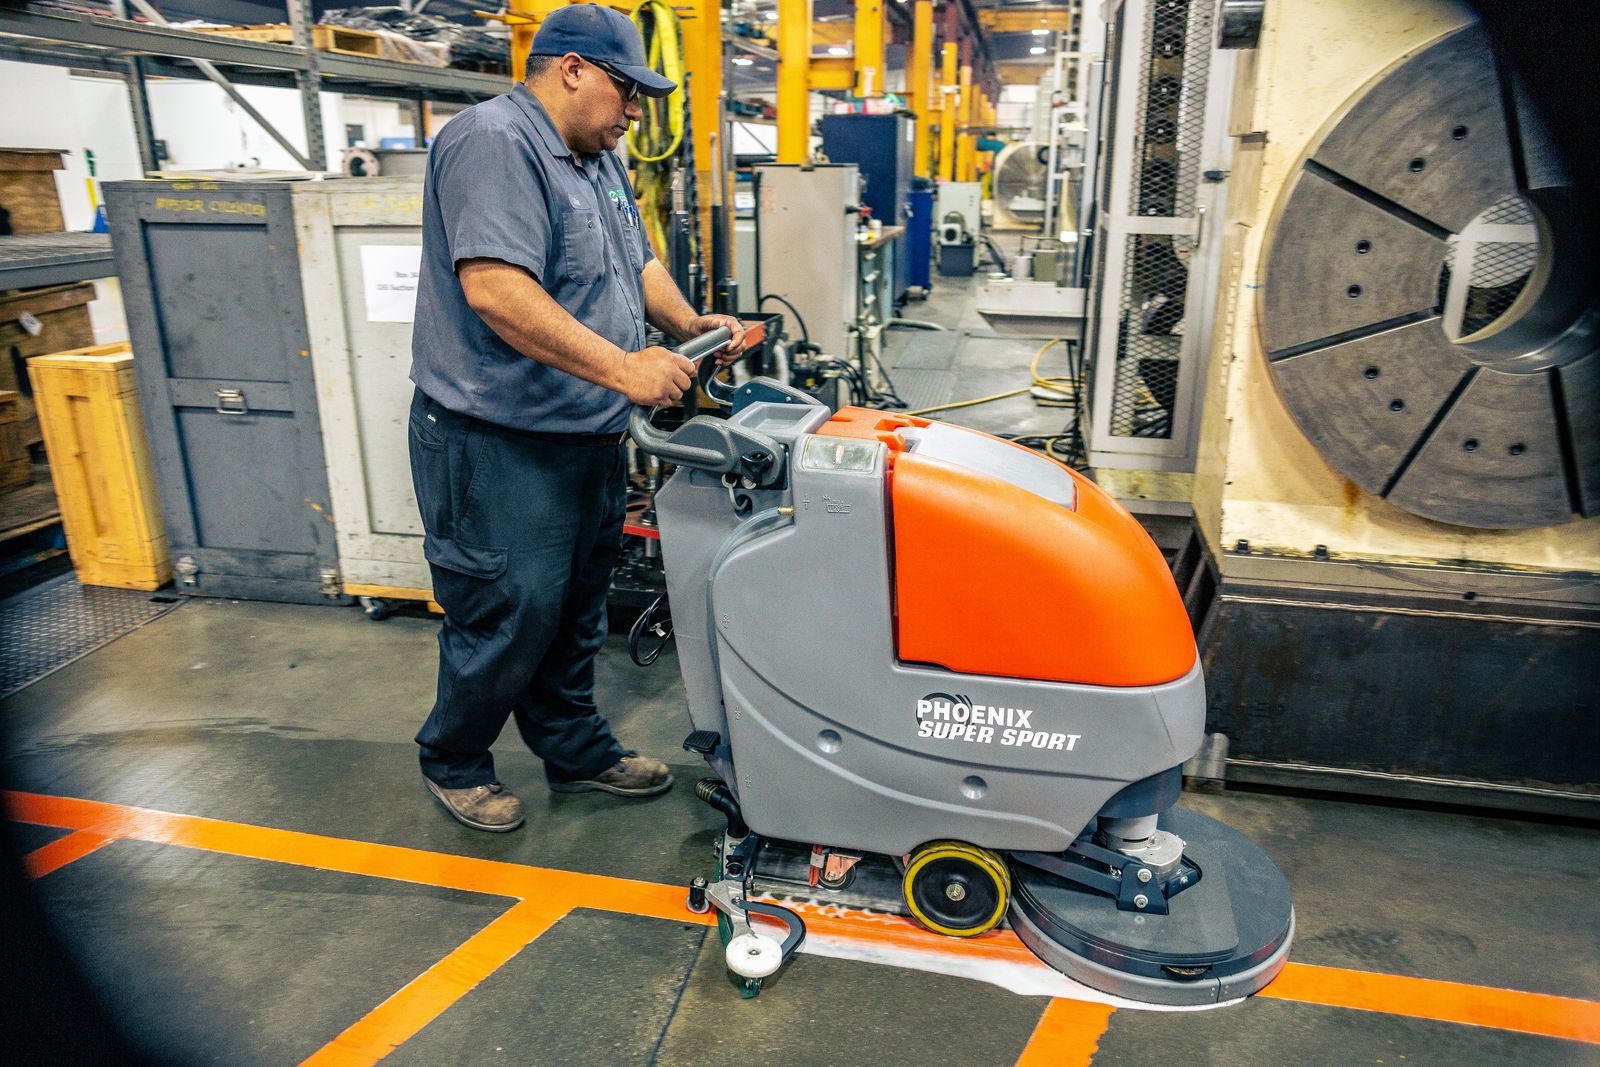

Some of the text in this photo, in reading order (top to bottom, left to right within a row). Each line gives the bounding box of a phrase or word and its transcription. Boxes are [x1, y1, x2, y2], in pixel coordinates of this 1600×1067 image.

[917, 699, 1034, 729] PHOENIX
[917, 720, 1081, 751] SUPER SPORT
